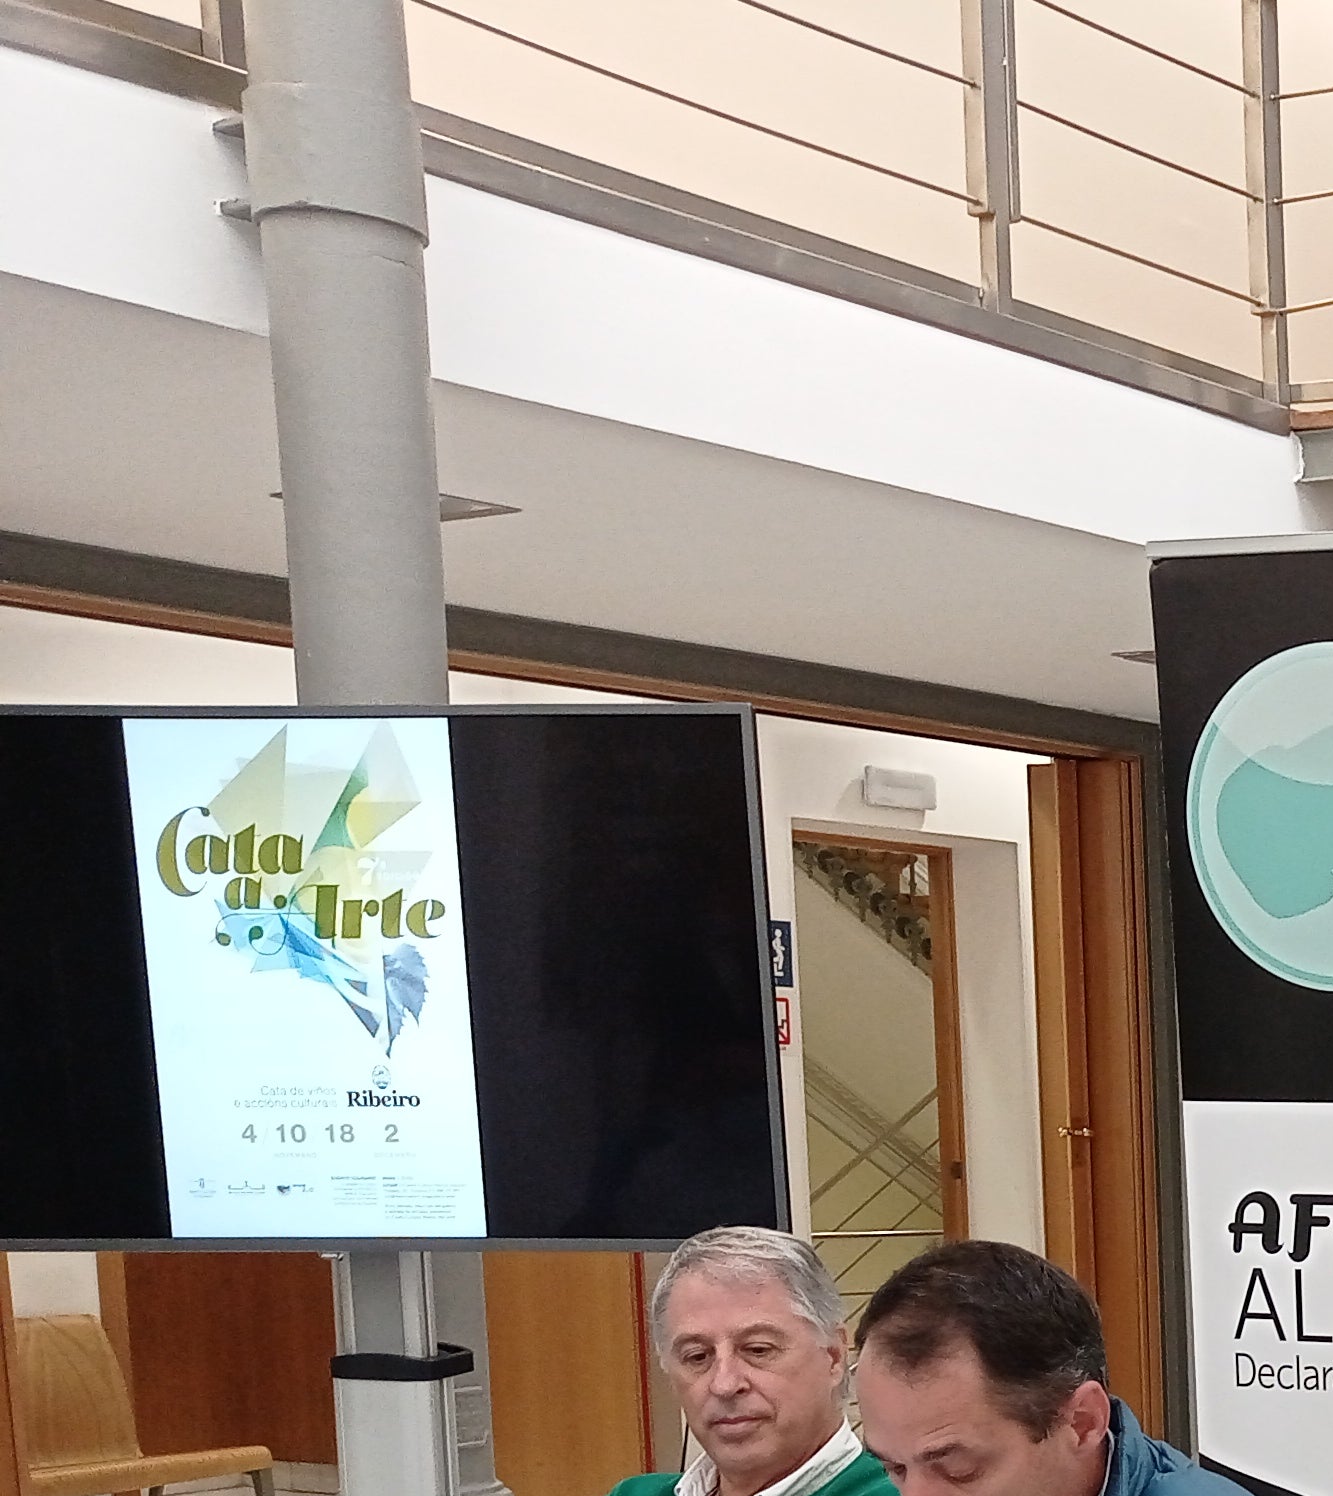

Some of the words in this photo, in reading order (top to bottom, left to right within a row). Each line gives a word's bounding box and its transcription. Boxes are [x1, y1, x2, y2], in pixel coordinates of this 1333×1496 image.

[156, 806, 304, 897] Cata
[245, 885, 446, 953] Arte
[346, 1089, 421, 1108] Ribeiro
[241, 1123, 258, 1144] 4
[275, 1123, 307, 1144] 10
[324, 1123, 355, 1144] 18
[383, 1123, 400, 1144] 2
